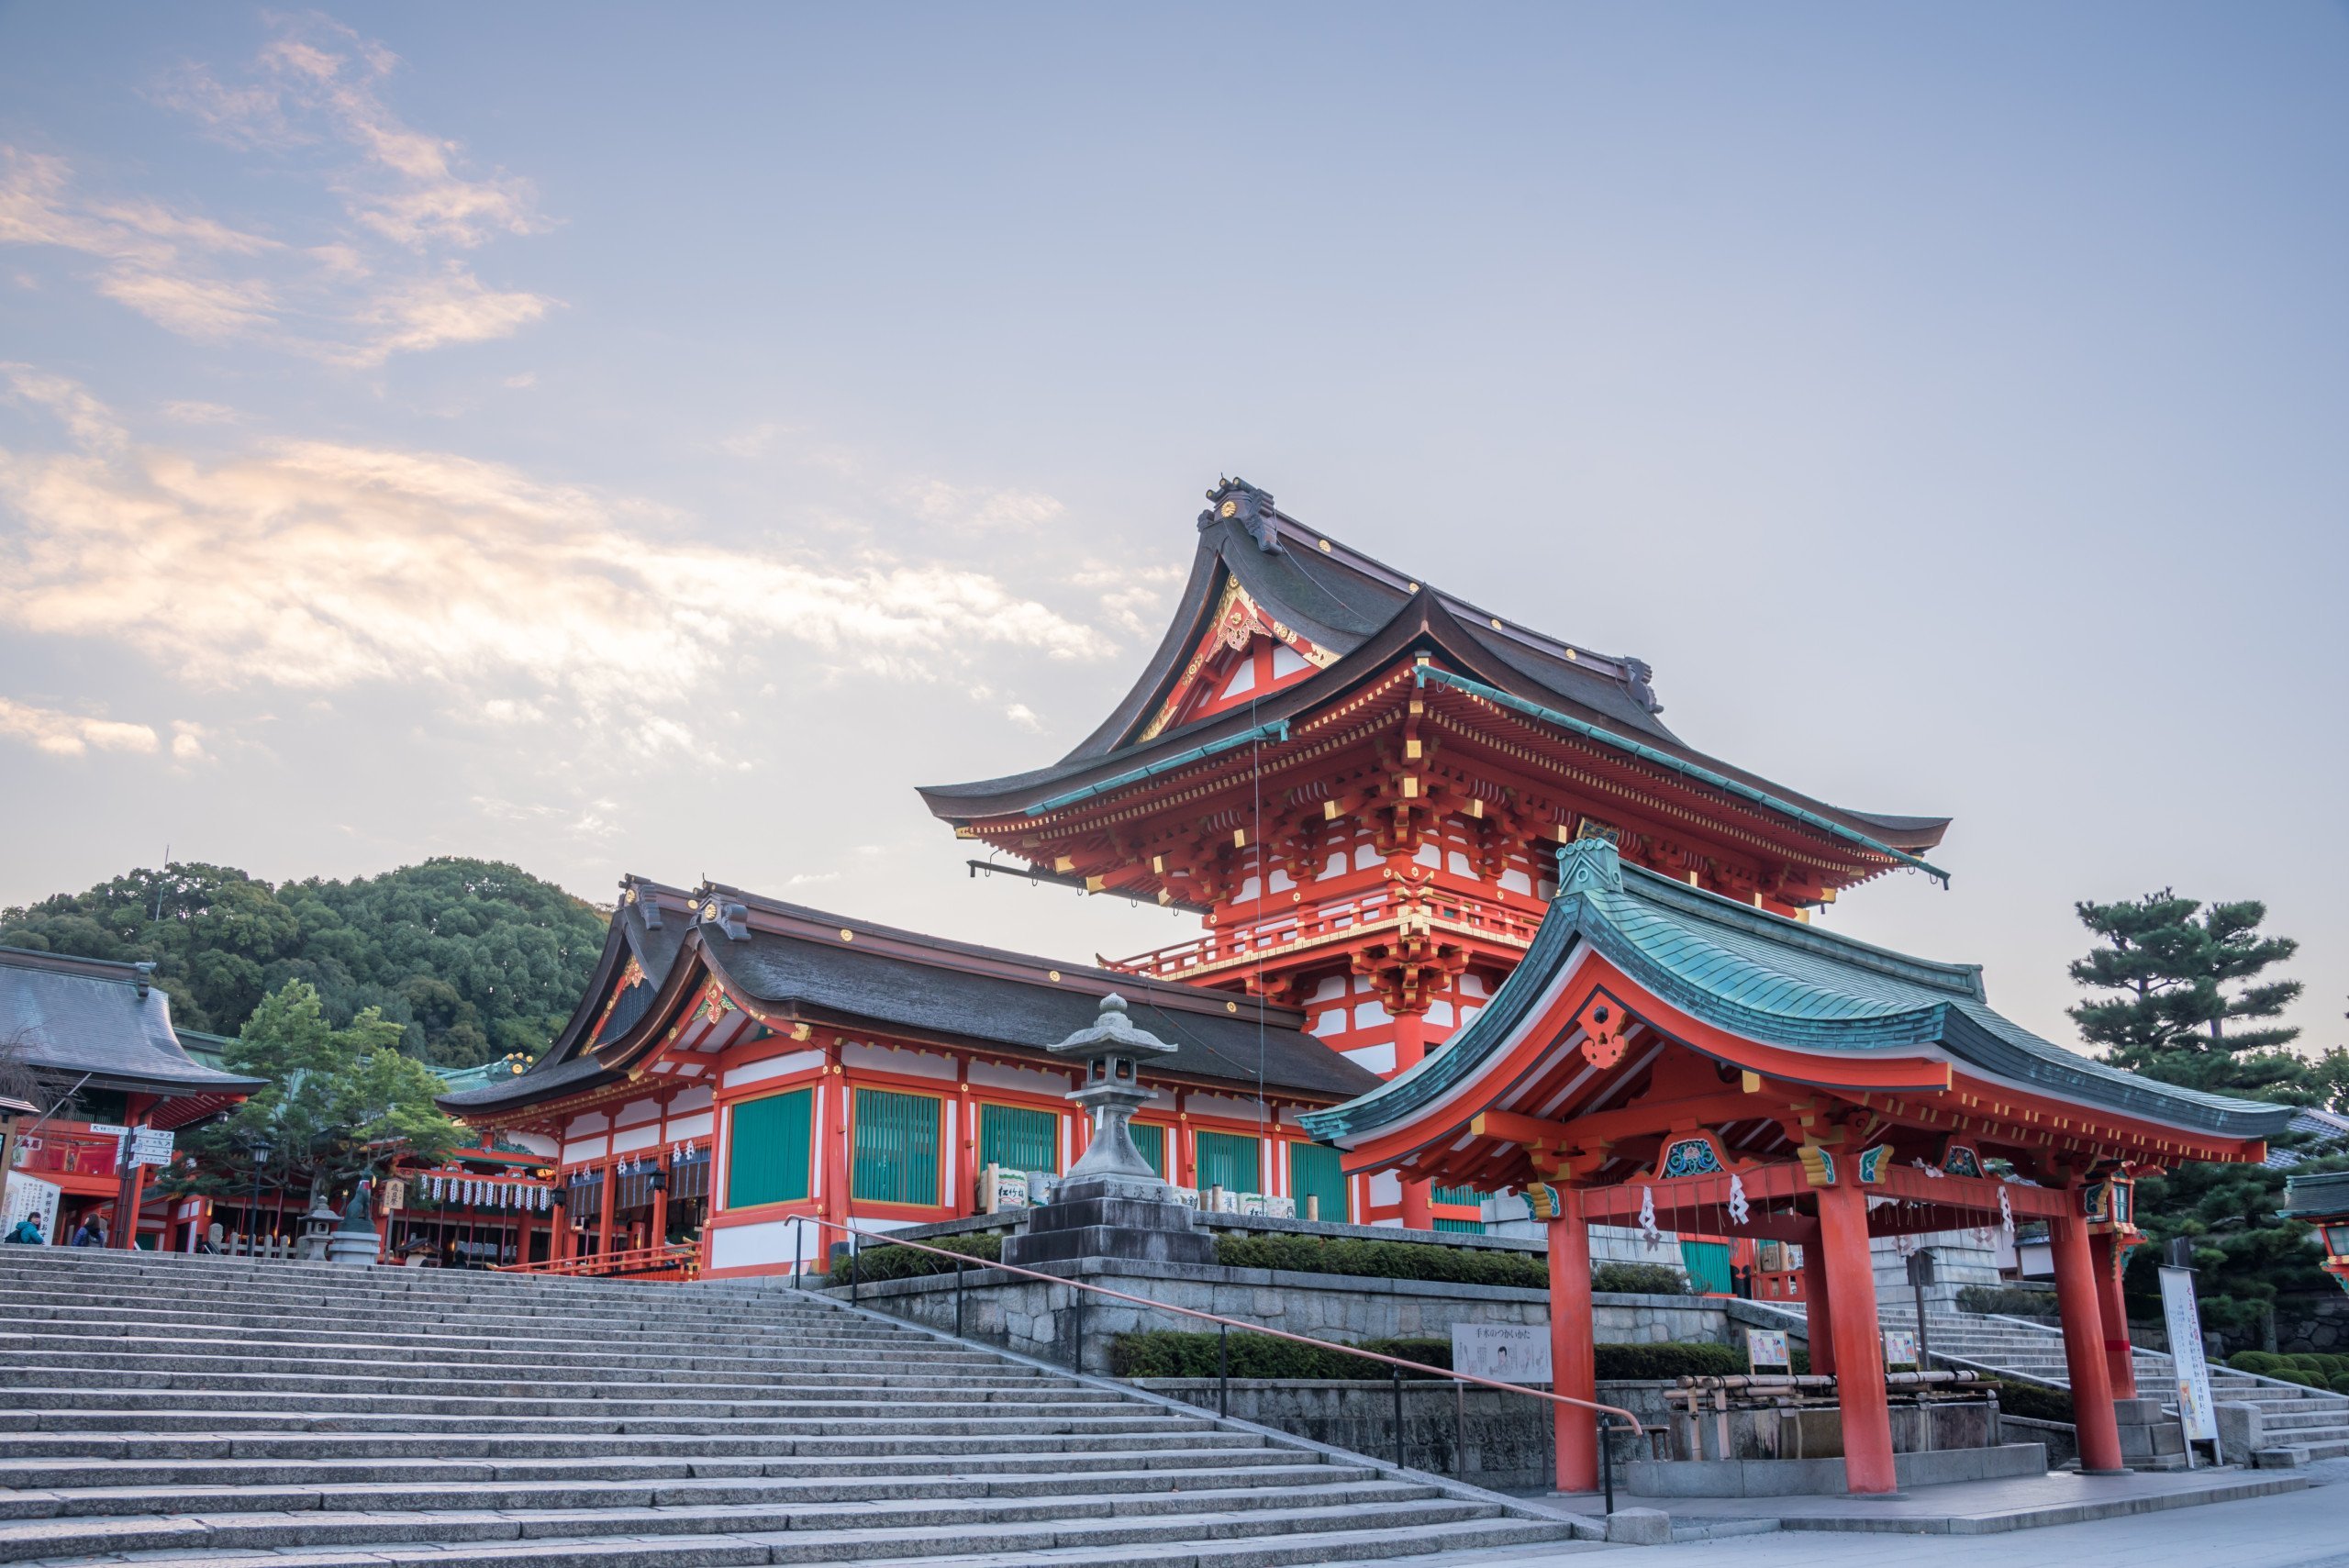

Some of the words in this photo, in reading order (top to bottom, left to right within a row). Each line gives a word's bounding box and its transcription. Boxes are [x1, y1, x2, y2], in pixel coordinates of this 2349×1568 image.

[1476, 1328, 1531, 1340] 手水のつかいかた
